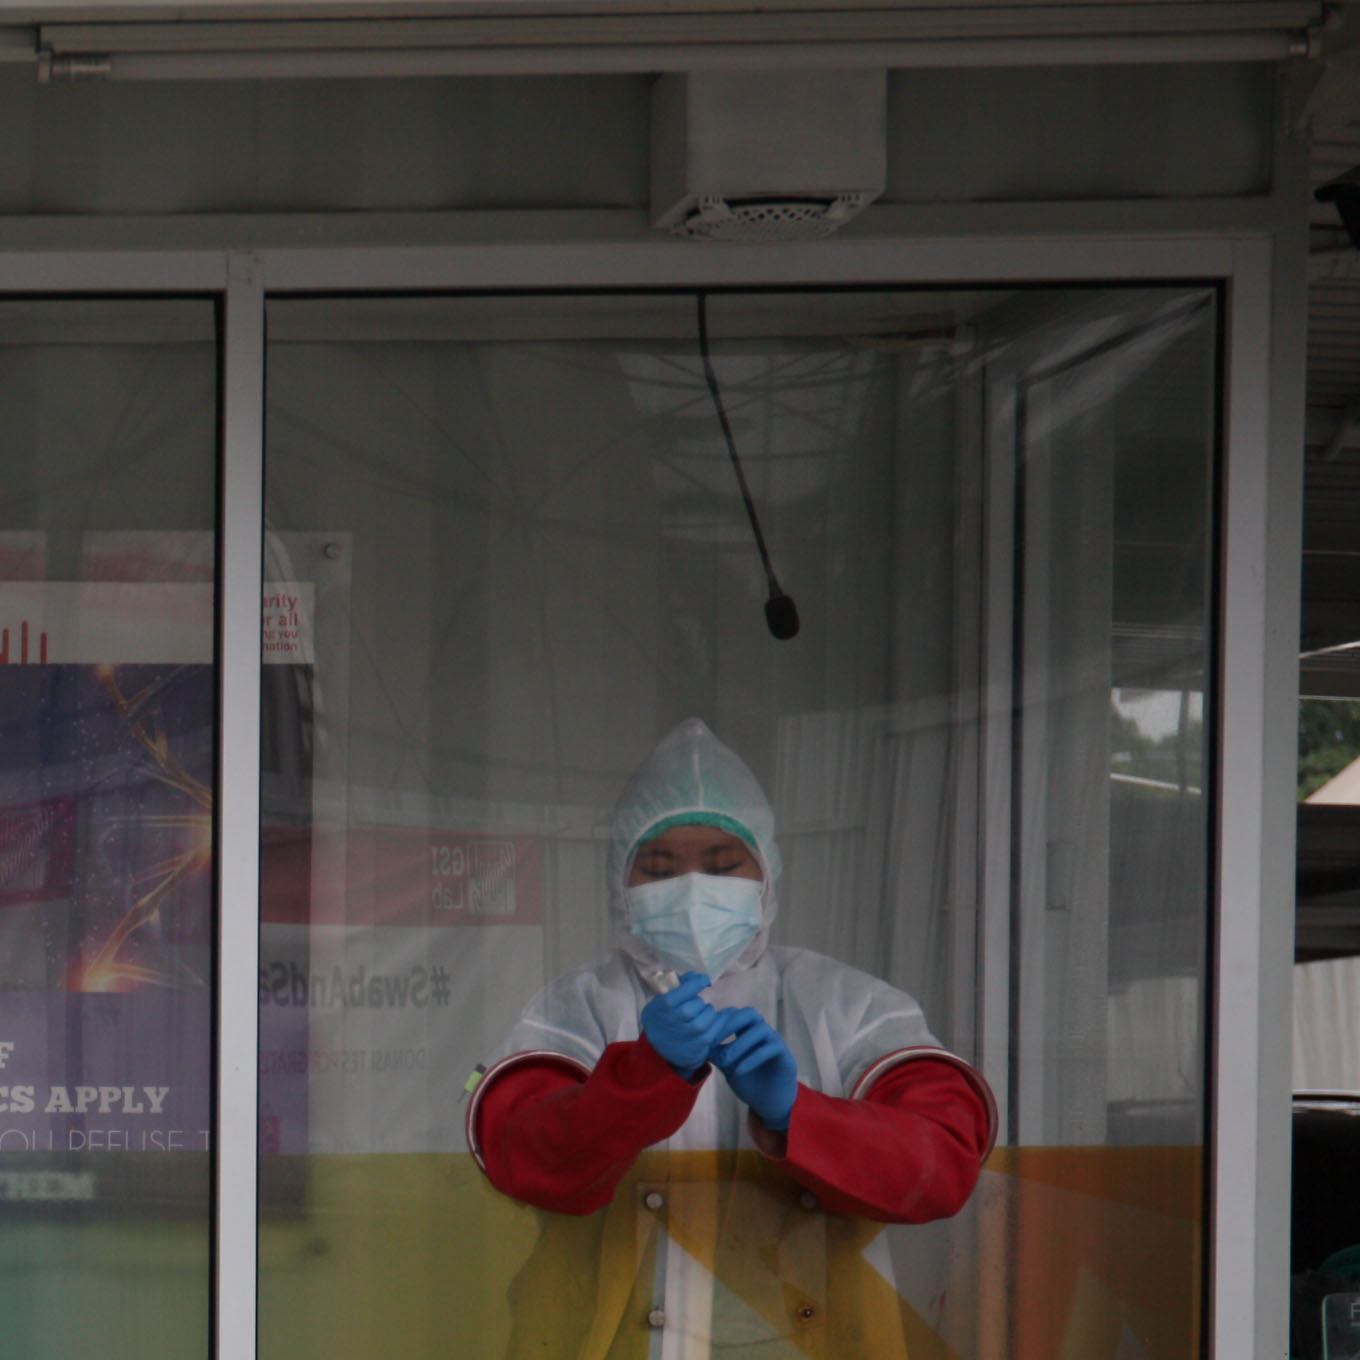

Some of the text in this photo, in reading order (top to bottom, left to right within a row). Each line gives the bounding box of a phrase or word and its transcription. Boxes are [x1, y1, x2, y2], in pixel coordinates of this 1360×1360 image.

[279, 613, 298, 626] all
[45, 1086, 170, 1114] APPLY
[69, 1129, 184, 1151] REFUSE
